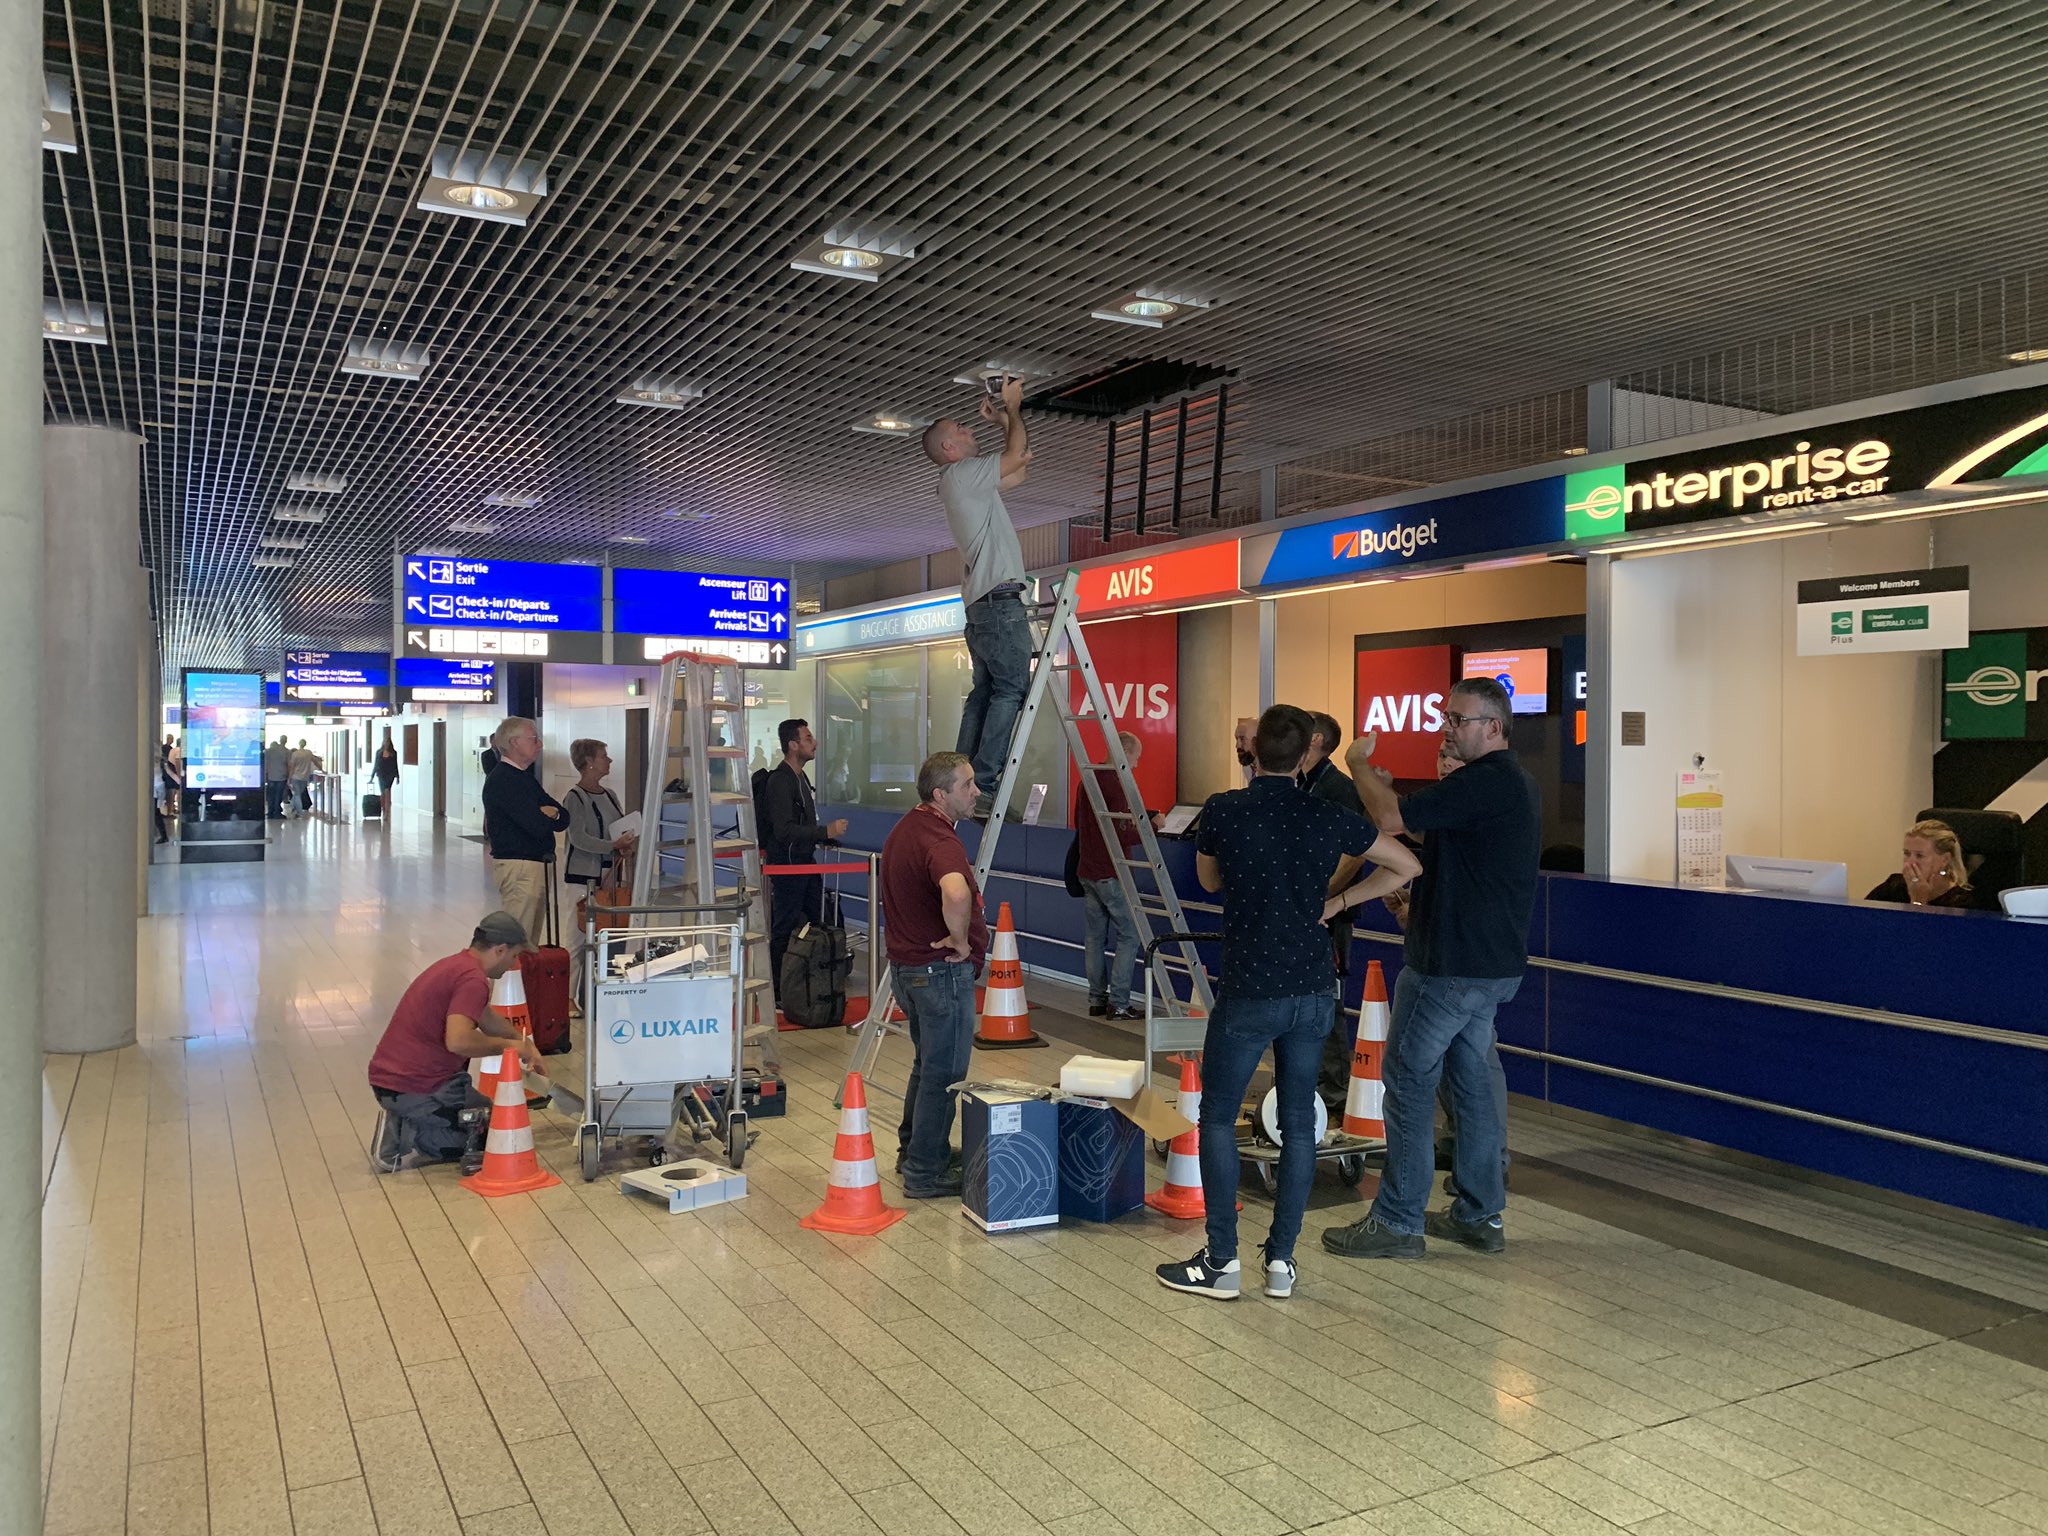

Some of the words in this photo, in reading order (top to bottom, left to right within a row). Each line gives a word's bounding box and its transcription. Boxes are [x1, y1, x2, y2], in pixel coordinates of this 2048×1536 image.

[1567, 440, 1891, 519] enterprise
[1762, 477, 1889, 509] rent-a-car
[1360, 518, 1438, 557] Budget
[455, 562, 488, 574] Sortie
[455, 575, 476, 585] Exit
[699, 577, 746, 589] Ascenseur
[1106, 565, 1153, 601] AVIS
[1840, 583, 1878, 593] Welcome
[1880, 579, 1920, 590] Members
[731, 590, 746, 600] Lift
[709, 609, 747, 619] Arrivées
[715, 621, 747, 631] Arrivals
[861, 618, 900, 639] BAGGAGE
[903, 609, 957, 632] ASSISTANCE
[1872, 619, 1905, 627] EMERALD
[1831, 635, 1853, 644] Plus
[1364, 692, 1444, 734] AVIS
[989, 969, 1017, 980] PORT
[641, 1018, 719, 1038] LUXAIR
